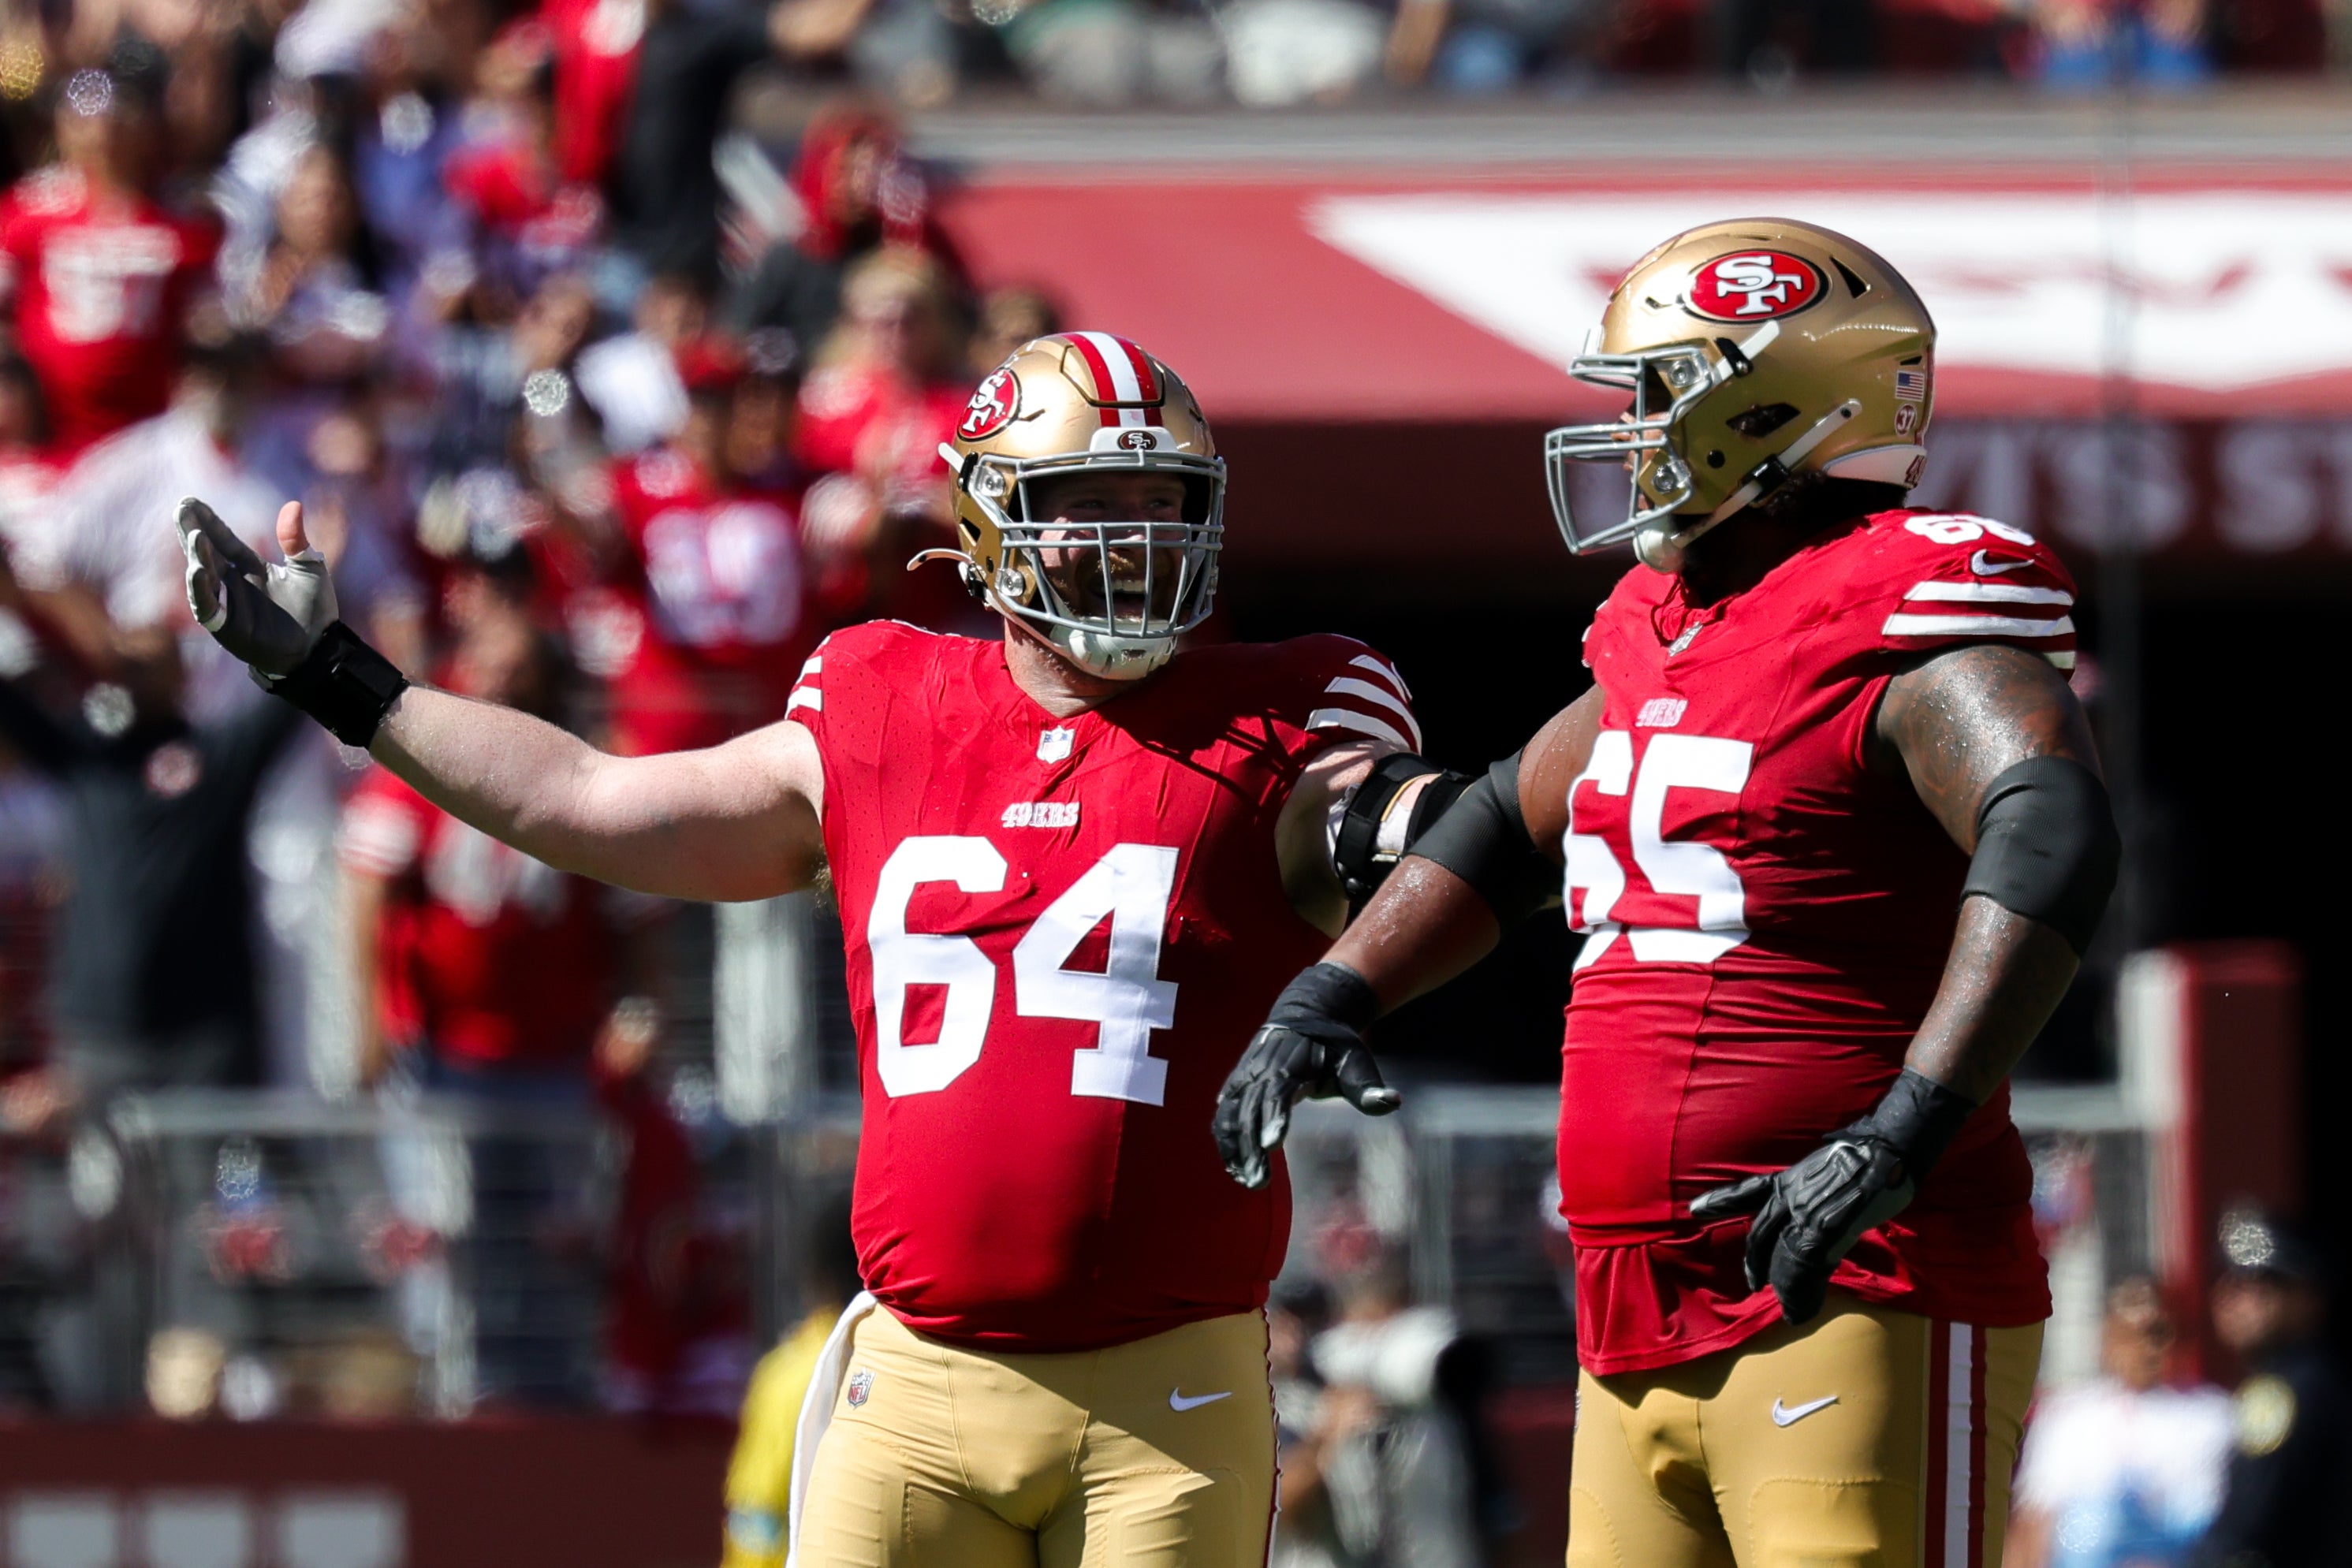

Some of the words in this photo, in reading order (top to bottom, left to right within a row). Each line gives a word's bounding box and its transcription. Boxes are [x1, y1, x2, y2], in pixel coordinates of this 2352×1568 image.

[1715, 255, 1802, 315] SF
[962, 374, 1007, 433] SF
[1897, 409, 1915, 432] 37
[1001, 801, 1080, 828] 49ERS
[1564, 730, 1751, 972] 65
[867, 835, 1180, 1107] 64
